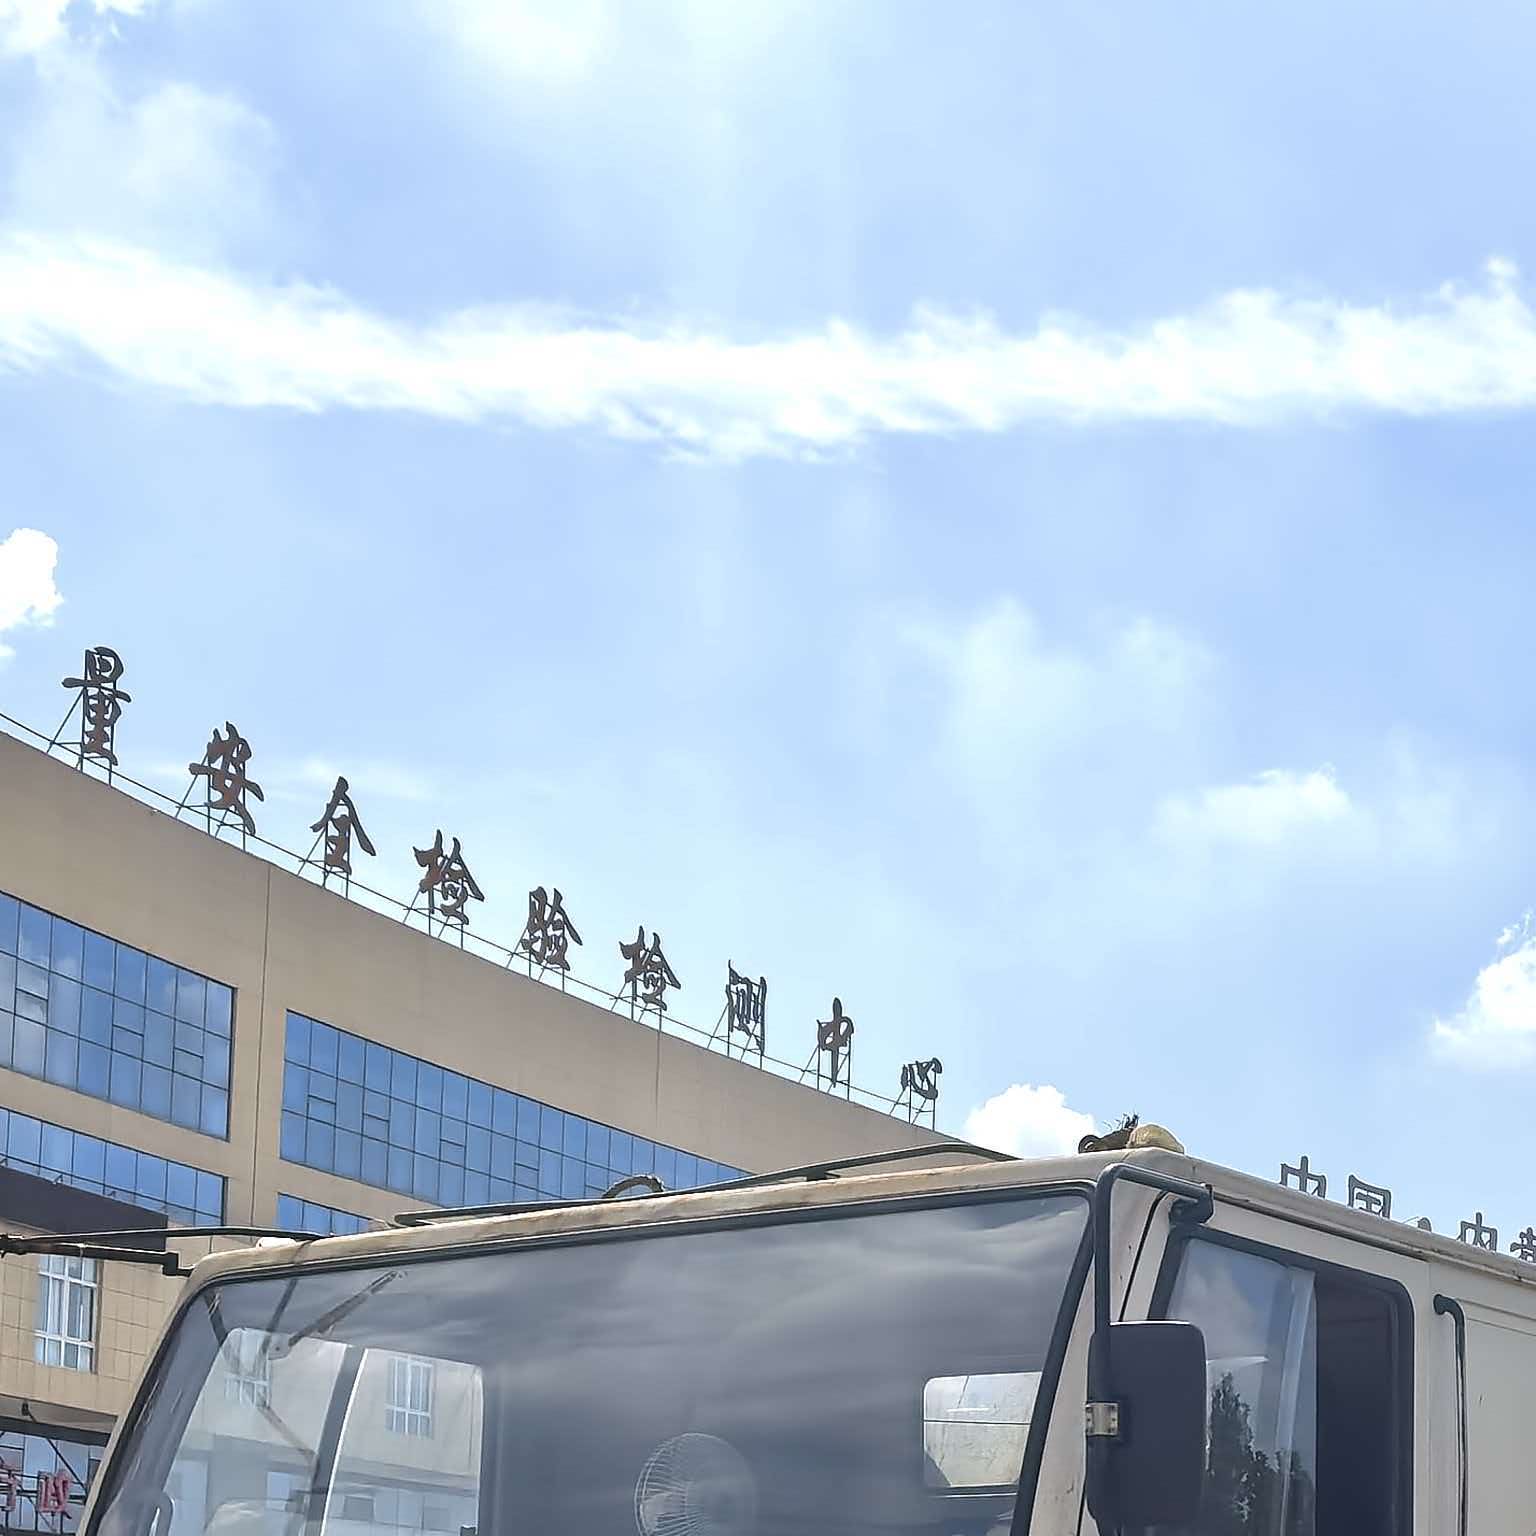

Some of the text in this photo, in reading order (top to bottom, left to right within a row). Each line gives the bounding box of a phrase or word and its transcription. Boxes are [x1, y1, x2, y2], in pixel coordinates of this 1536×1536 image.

[62, 646, 944, 1101] 量安全检验检测中心
